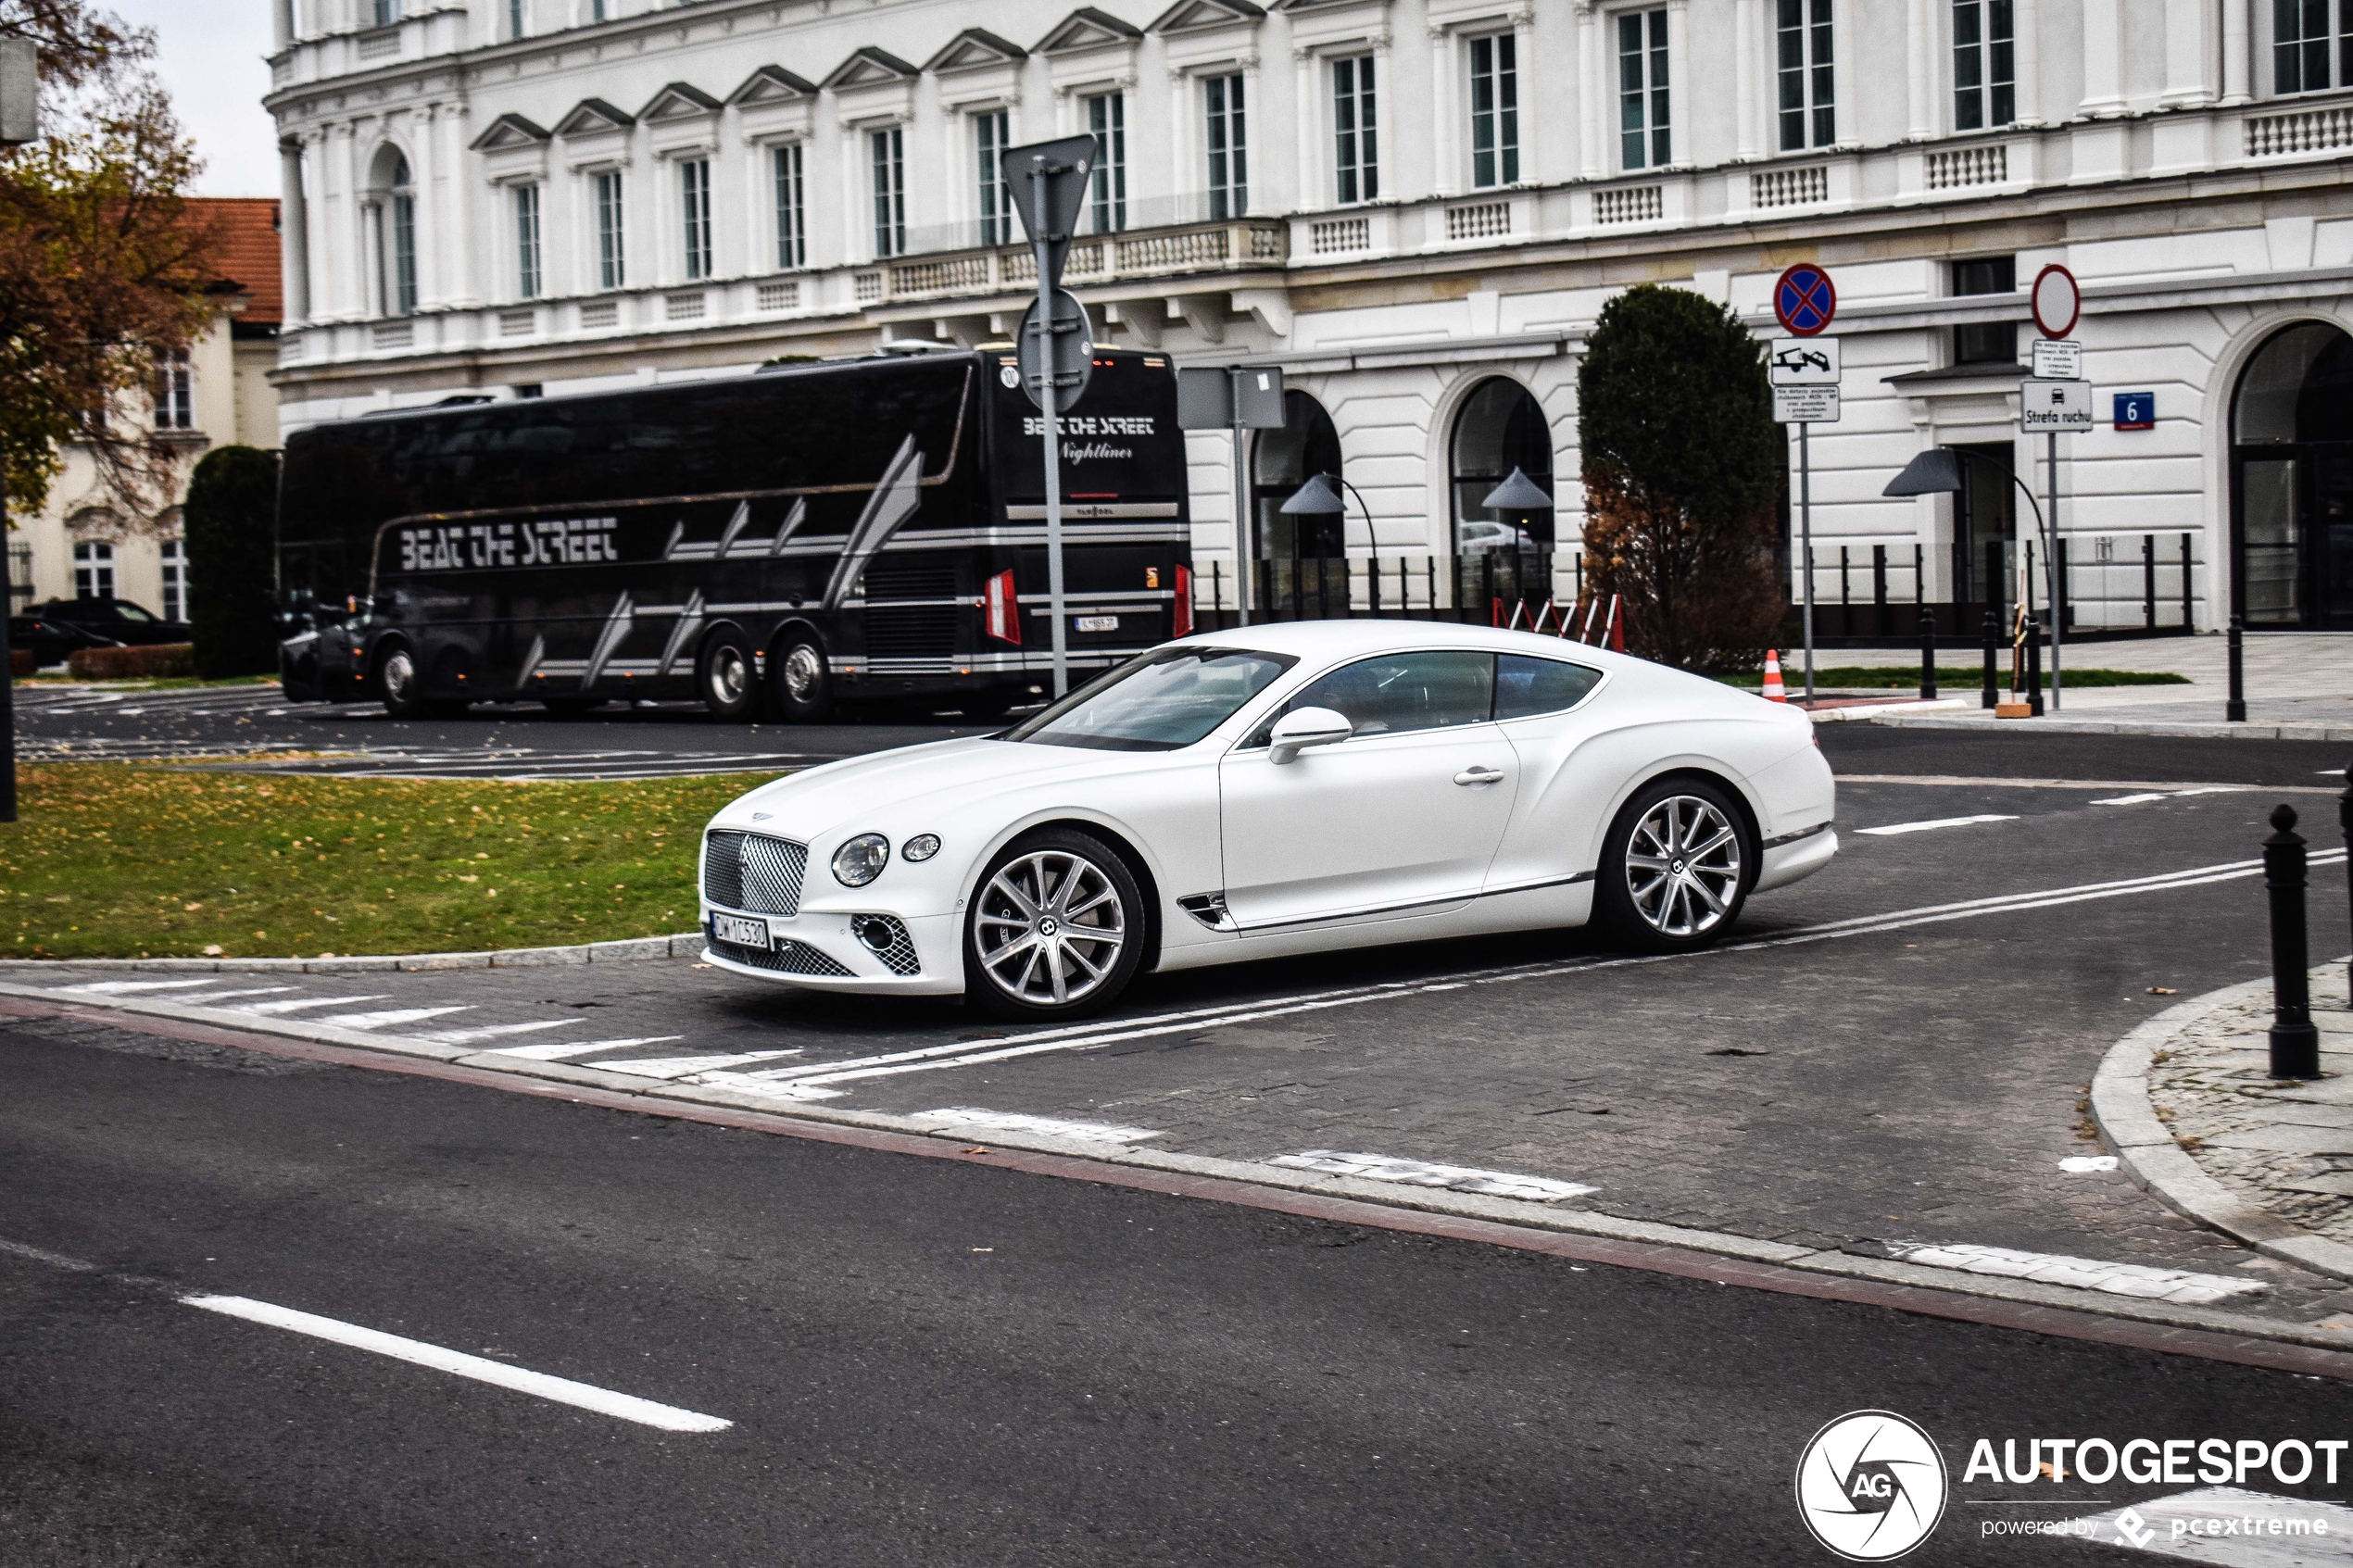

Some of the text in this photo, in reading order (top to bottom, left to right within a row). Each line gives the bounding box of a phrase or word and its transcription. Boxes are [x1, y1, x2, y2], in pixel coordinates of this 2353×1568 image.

[2026, 408, 2092, 423] Strefa ruchu
[2127, 401, 2138, 421] 6
[1023, 417, 1155, 435] BET THE STREET
[400, 517, 618, 571] BEAT THE STREET
